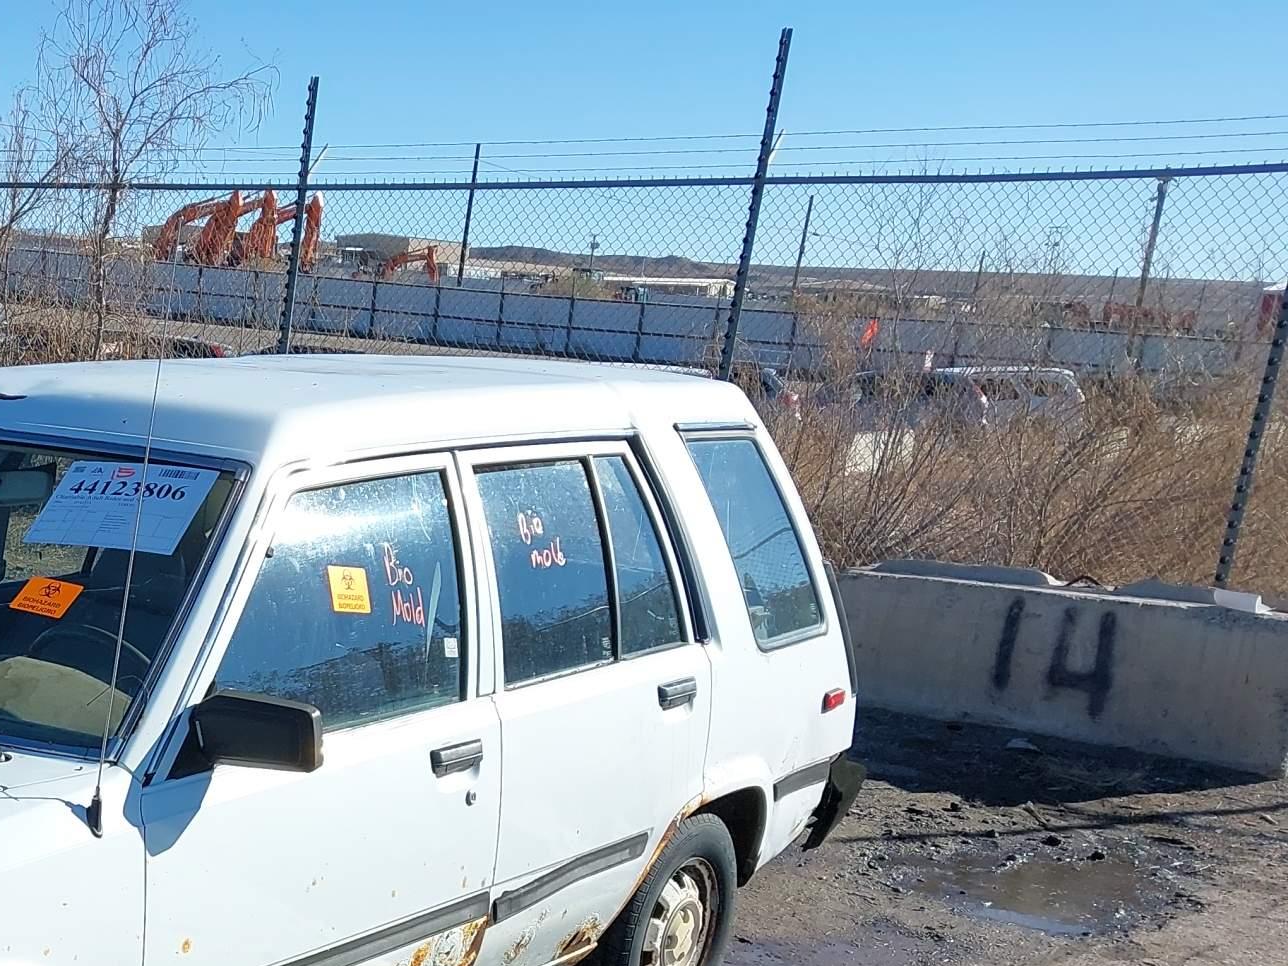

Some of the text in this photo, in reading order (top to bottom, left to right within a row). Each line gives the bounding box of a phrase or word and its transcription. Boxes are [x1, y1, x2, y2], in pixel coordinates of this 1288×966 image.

[69, 479, 192, 501] 44123806
[17, 602, 57, 615] BIOPELIGRO
[22, 596, 61, 608] BIOHAZARD
[391, 586, 426, 628] Mold
[990, 598, 1116, 722] 14
